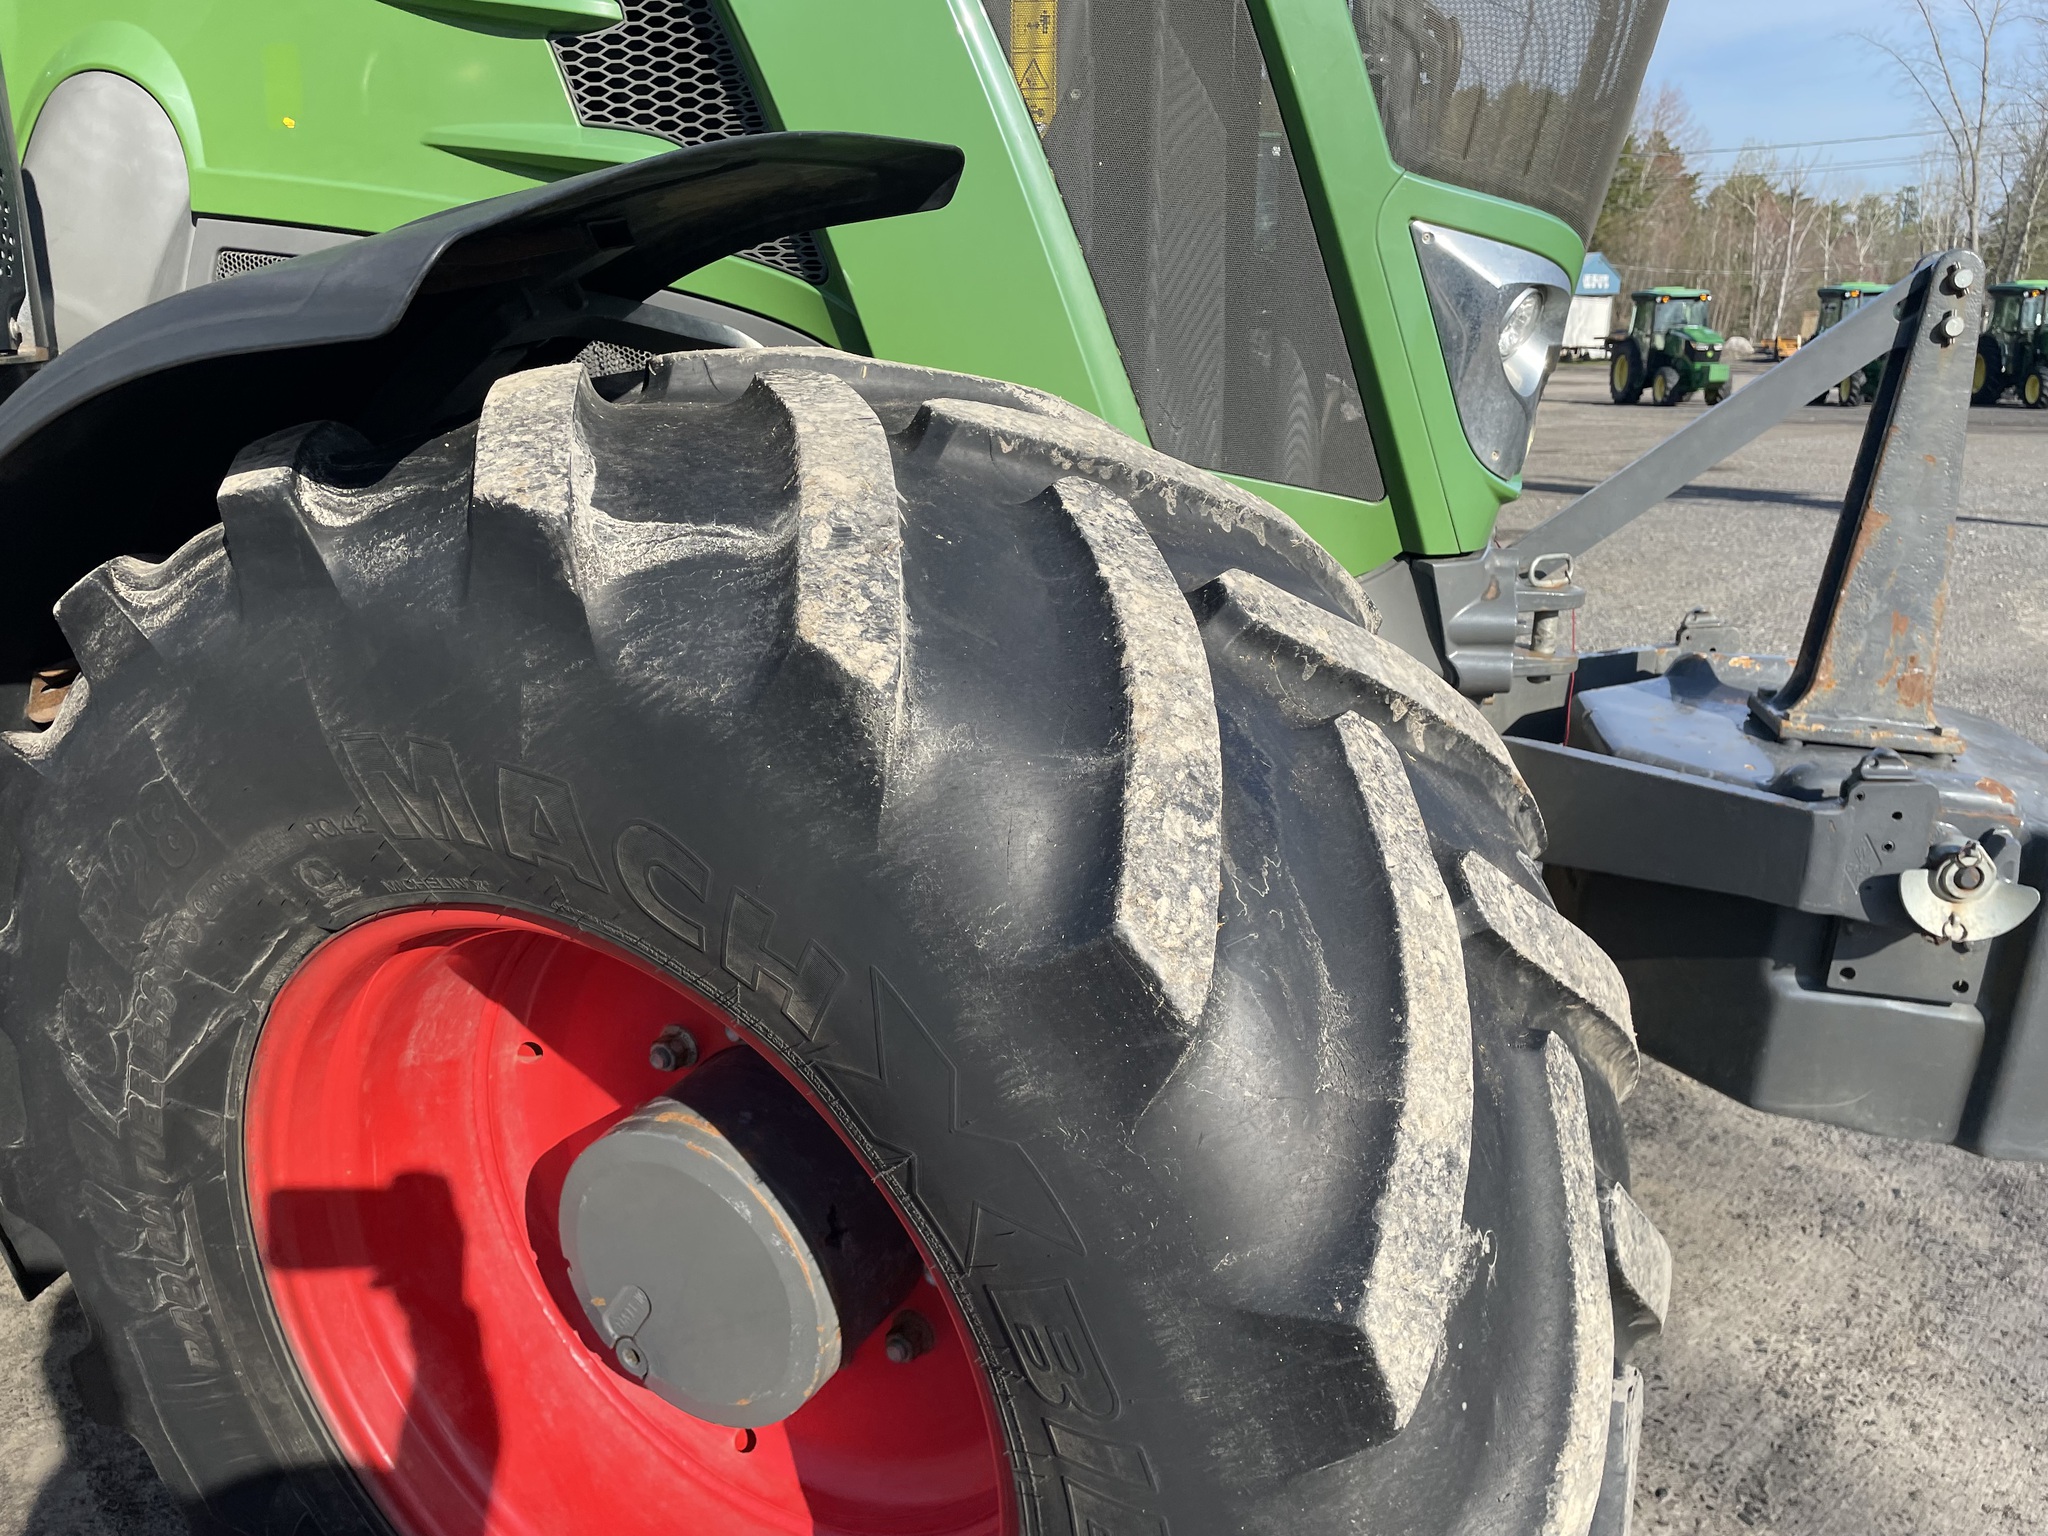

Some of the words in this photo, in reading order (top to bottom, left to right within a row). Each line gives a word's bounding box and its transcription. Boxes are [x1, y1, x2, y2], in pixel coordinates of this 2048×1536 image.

[379, 876, 469, 893] MICHELIN
[127, 966, 178, 1184] TUBELESS
[140, 1205, 221, 1370] RADIAL
